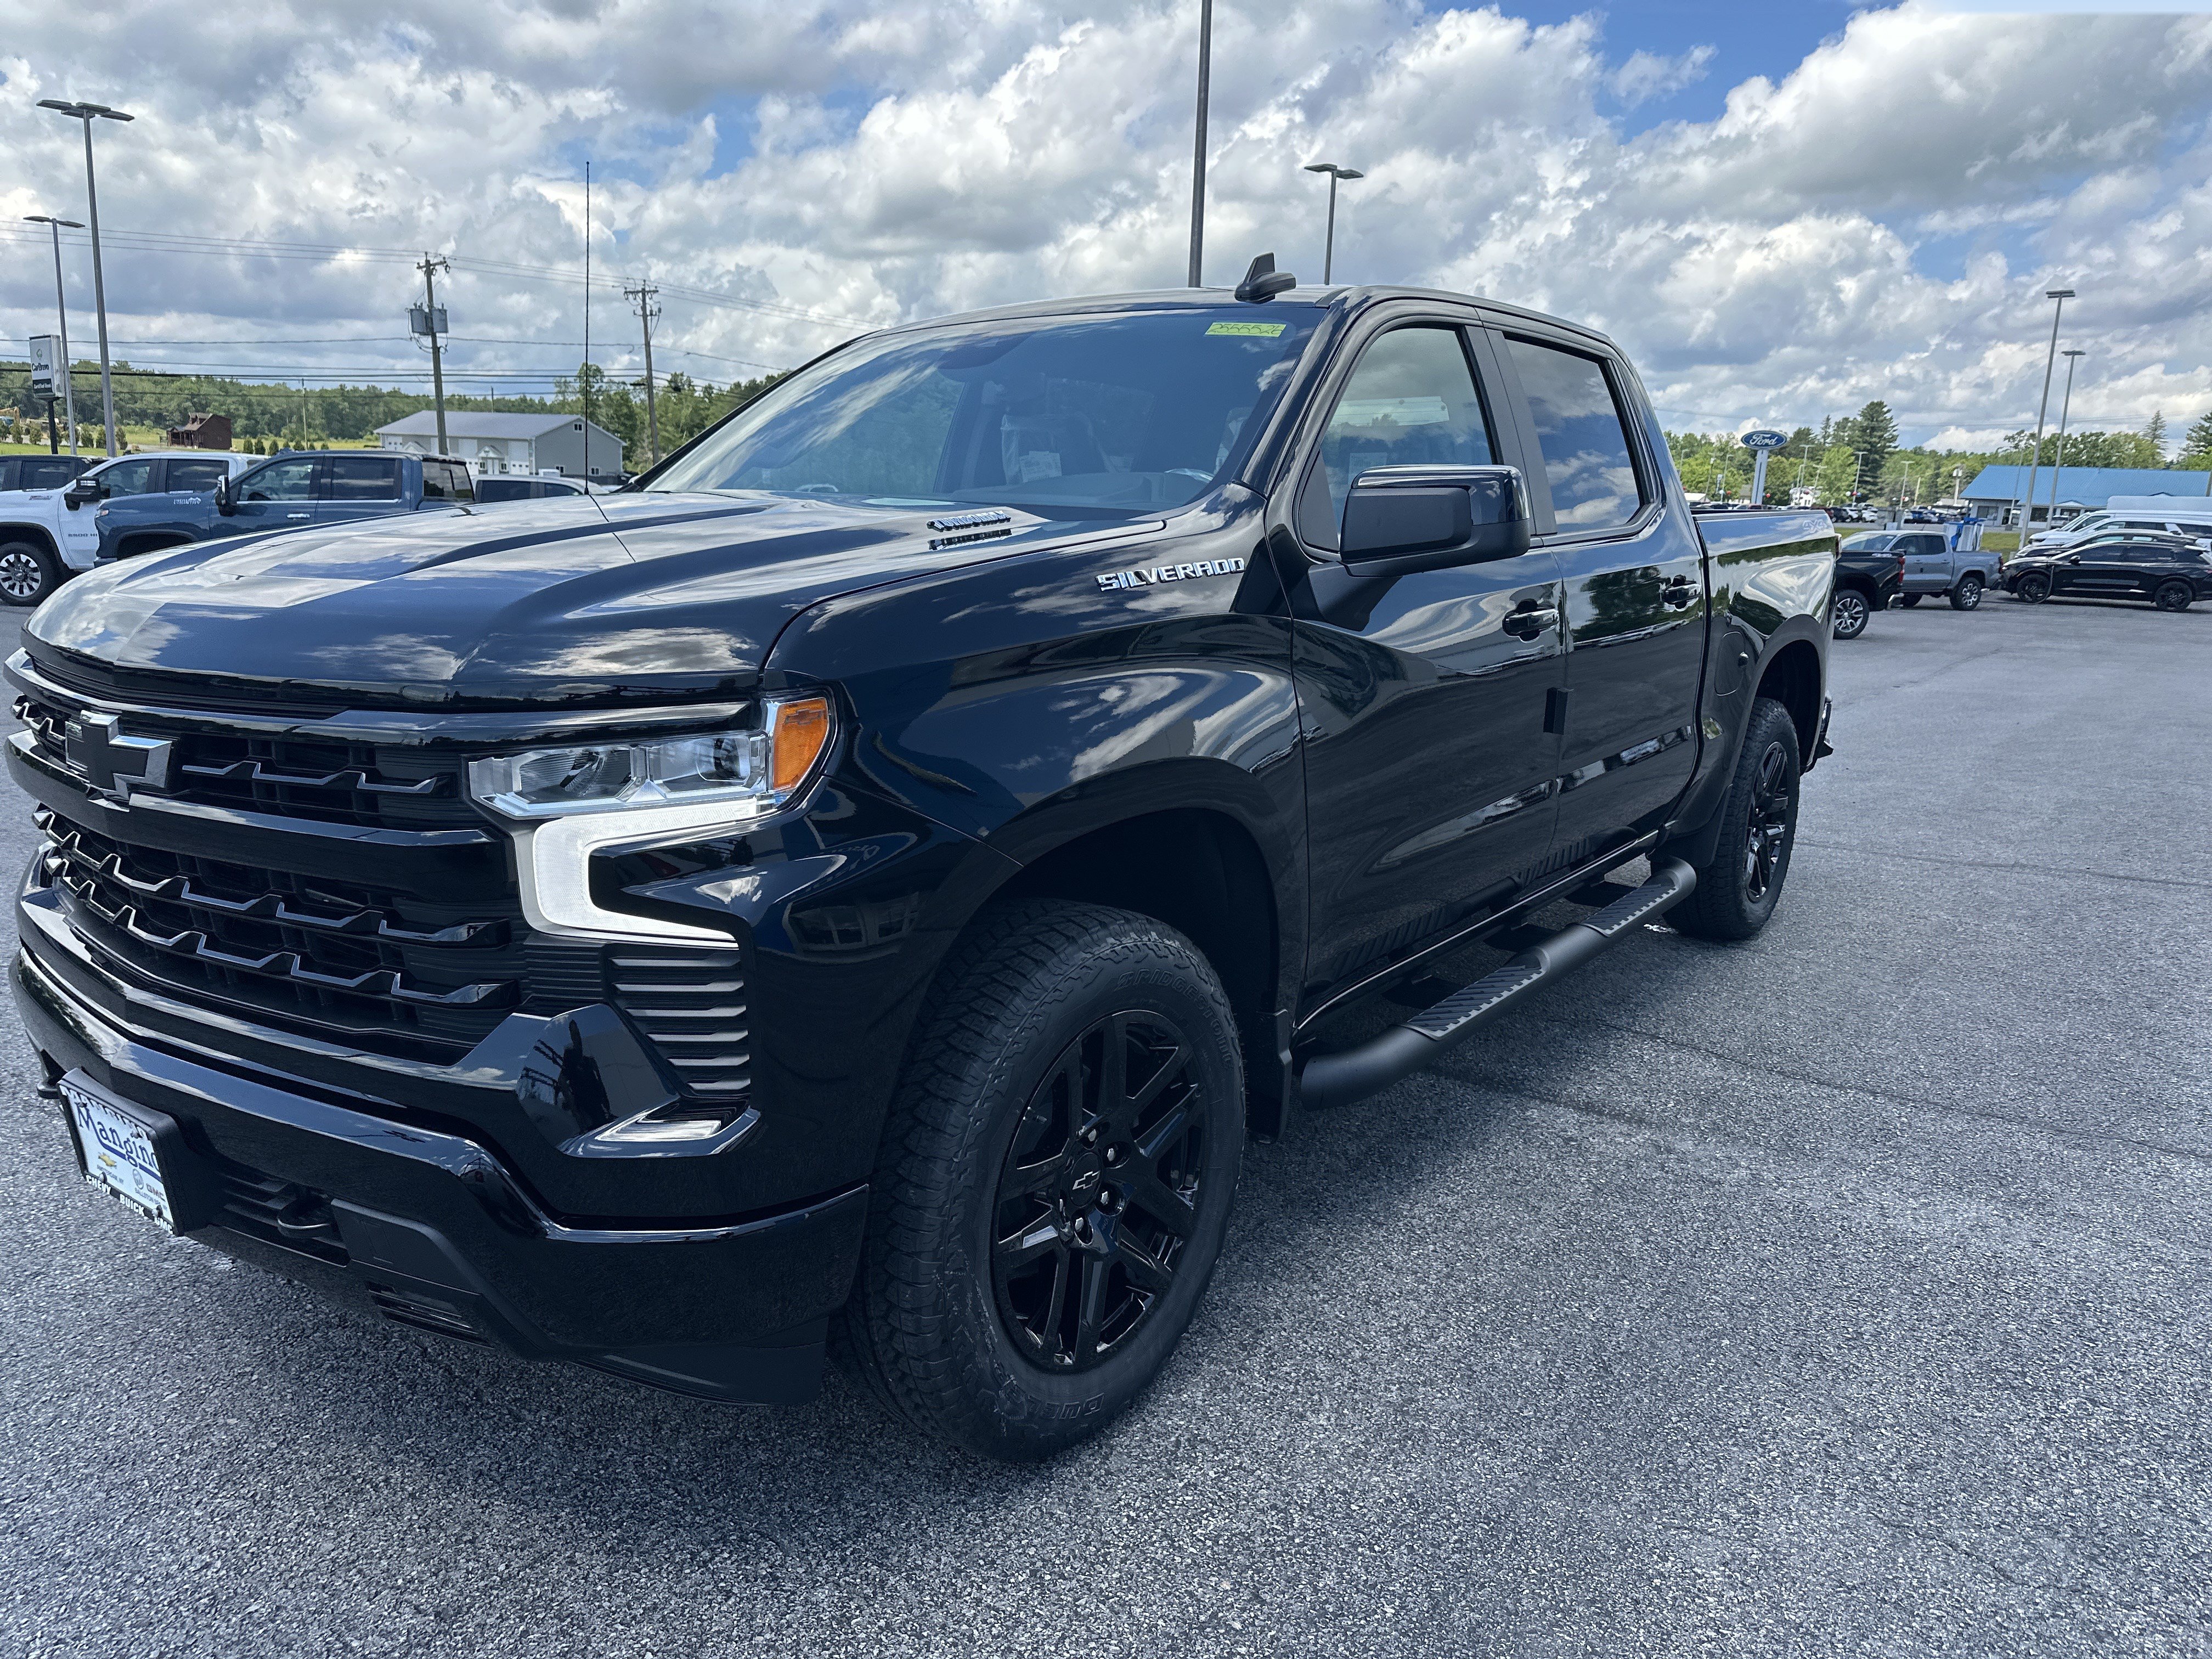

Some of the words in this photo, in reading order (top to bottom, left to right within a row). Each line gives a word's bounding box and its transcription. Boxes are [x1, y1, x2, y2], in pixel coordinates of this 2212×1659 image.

[1749, 433, 1778, 445] Ford
[1096, 557, 1245, 592] SILVERADO
[1114, 968, 1234, 1069] BRIDGESTONE
[86, 1175, 112, 1195] CHEVY
[146, 1183, 166, 1202] GMC
[120, 1193, 145, 1216] BUICK
